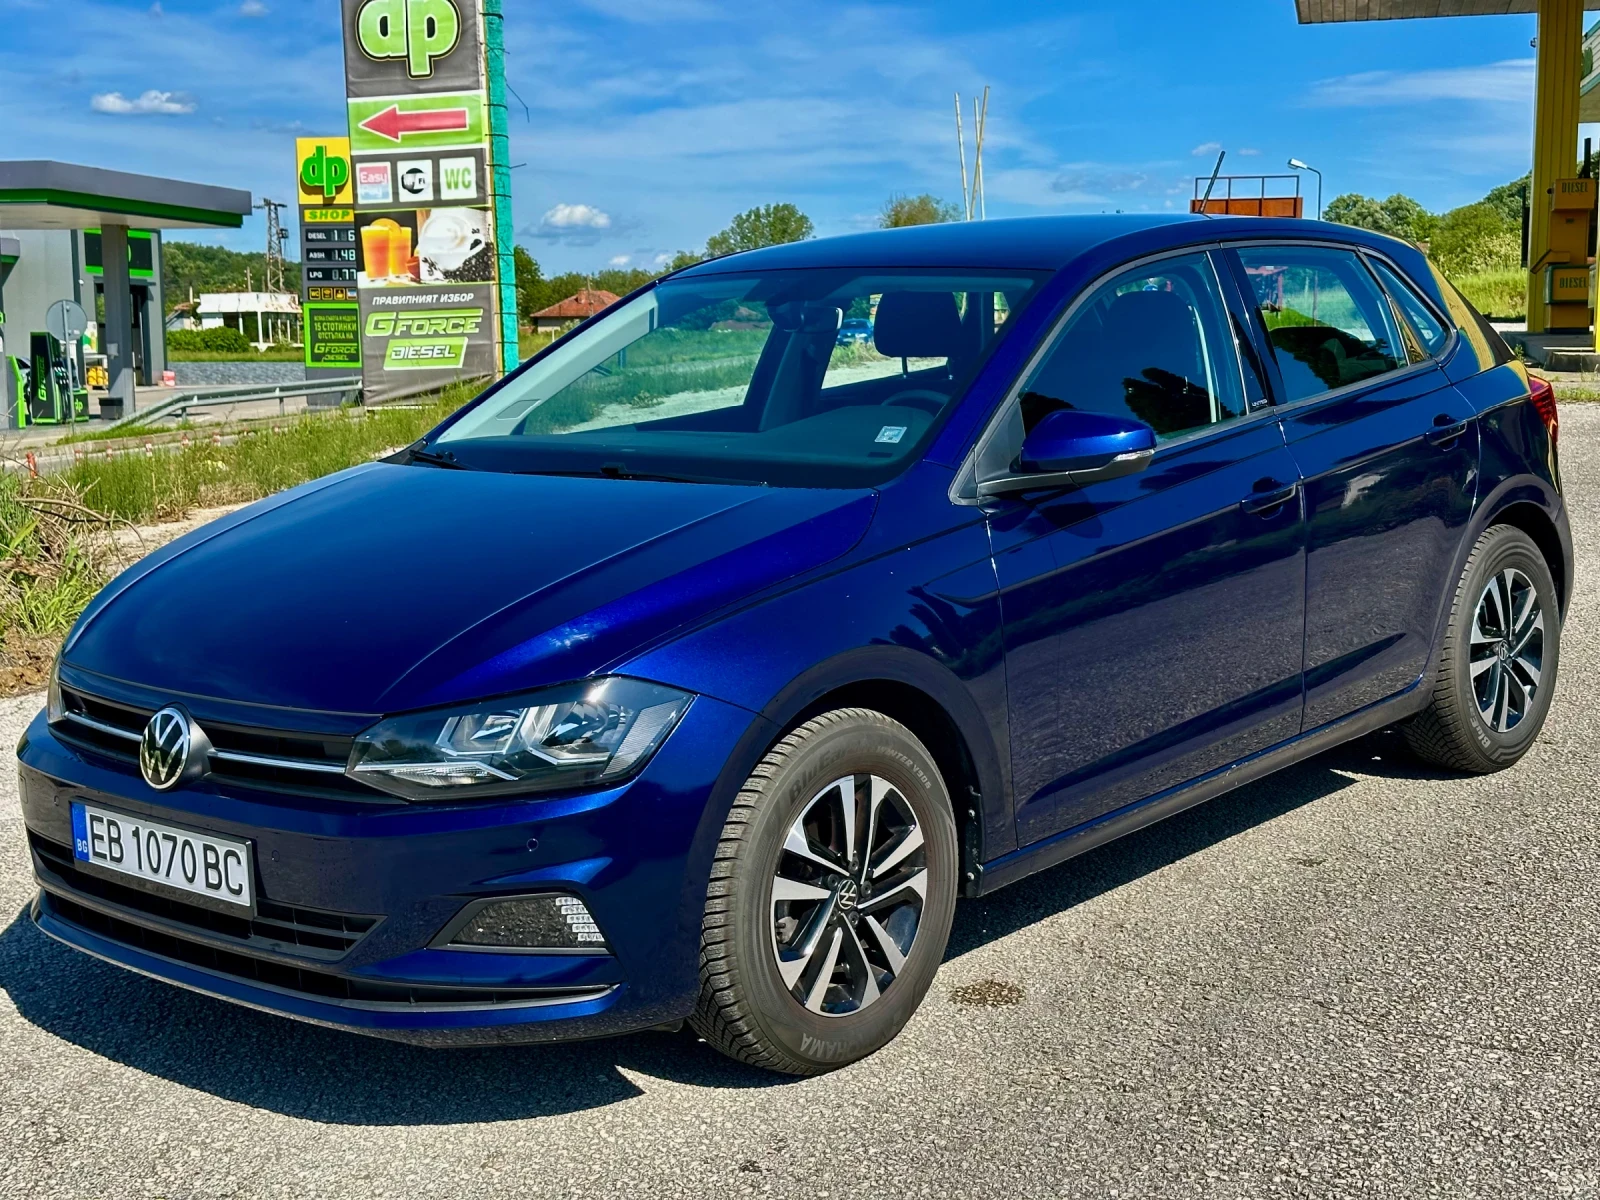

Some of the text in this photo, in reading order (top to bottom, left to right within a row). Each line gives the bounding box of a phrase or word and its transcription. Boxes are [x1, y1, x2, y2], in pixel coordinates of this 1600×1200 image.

[302, 145, 348, 197] dp
[360, 171, 388, 185] Easy
[444, 168, 472, 190] WC
[1562, 182, 1588, 193] DIESEL
[308, 210, 350, 220] SHOP
[309, 271, 323, 279] LPG
[1559, 277, 1588, 289] DIESEL
[372, 292, 475, 306] ПРАВИЛНИЯТ ИЗБОР
[314, 322, 357, 331] 15 СТОТИНКИ
[391, 345, 456, 359] DIESEL
[77, 838, 88, 853] BG
[89, 813, 243, 896] EB 1070 BC
